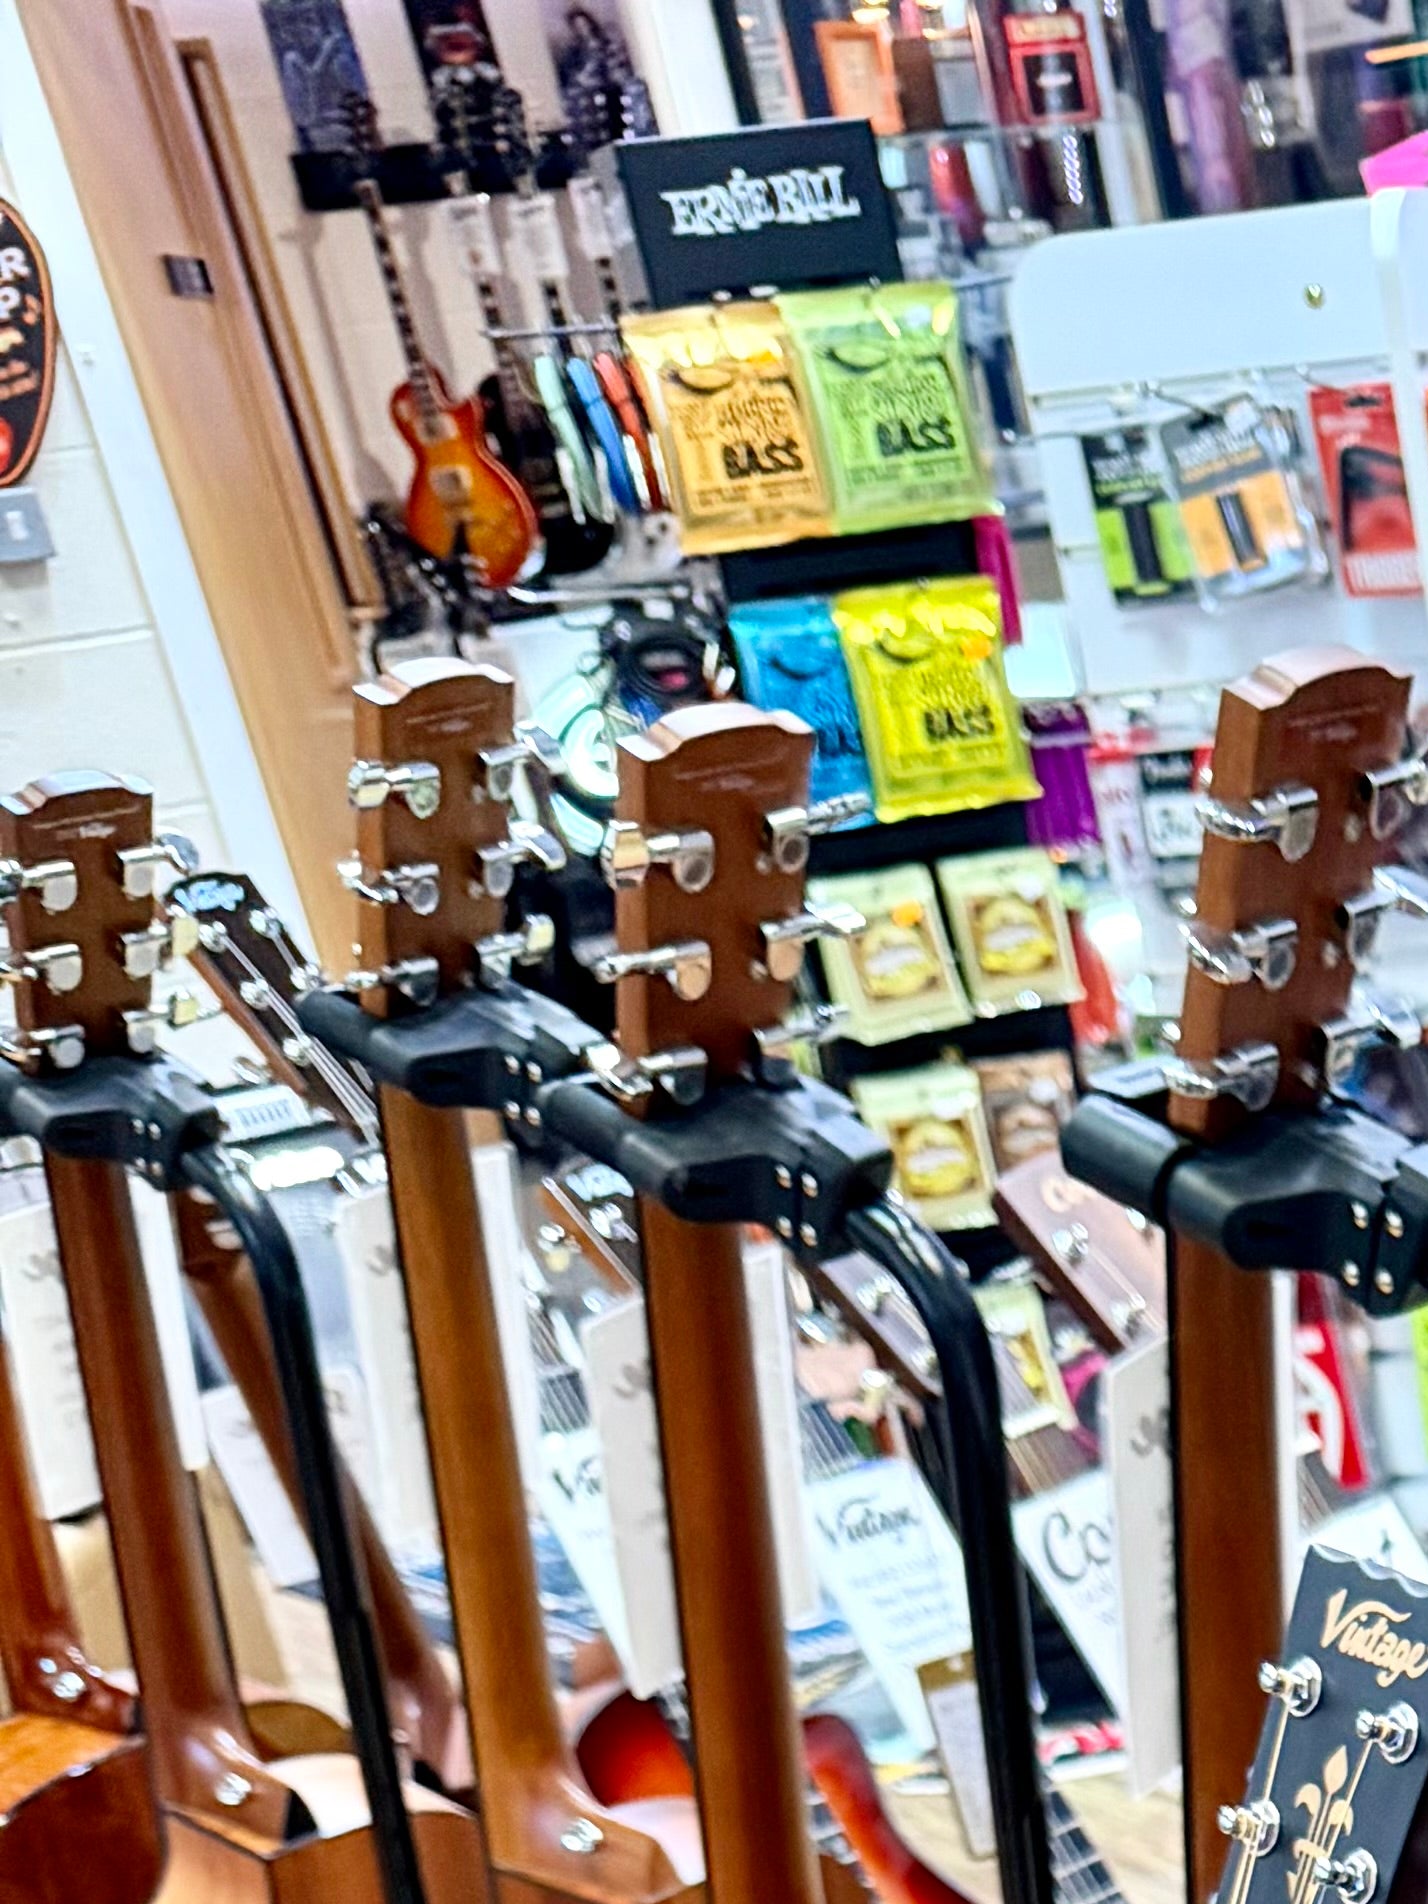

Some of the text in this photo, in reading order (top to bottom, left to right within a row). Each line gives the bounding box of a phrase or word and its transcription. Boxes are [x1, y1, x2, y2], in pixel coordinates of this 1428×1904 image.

[659, 166, 861, 237] ERNIE BALL
[877, 413, 956, 458] BASS
[723, 437, 803, 480] BASS
